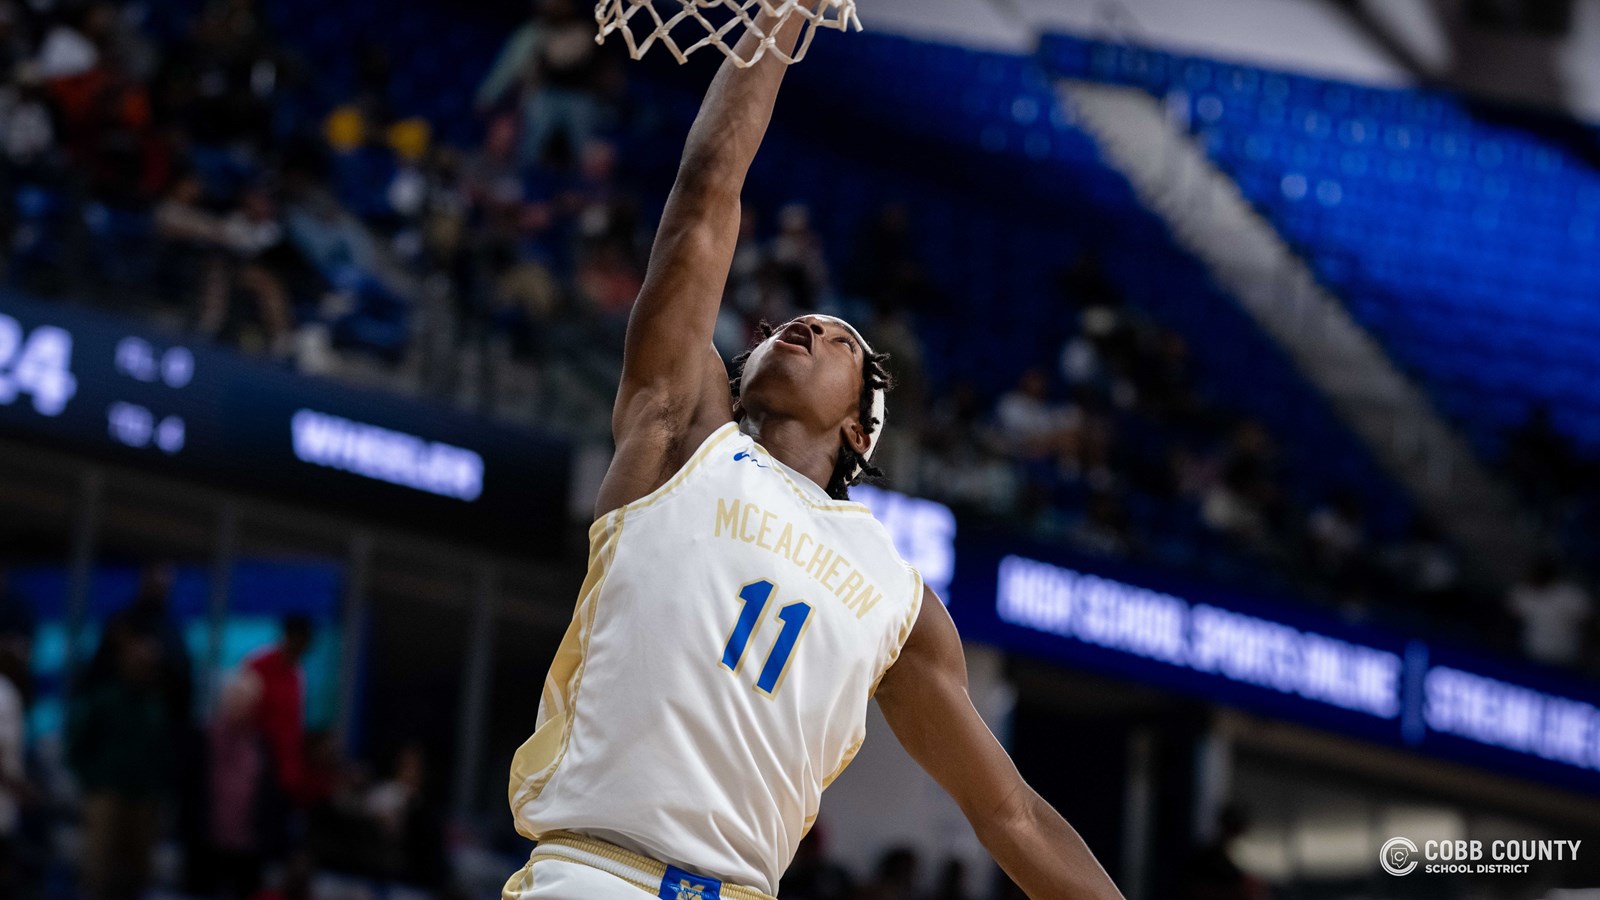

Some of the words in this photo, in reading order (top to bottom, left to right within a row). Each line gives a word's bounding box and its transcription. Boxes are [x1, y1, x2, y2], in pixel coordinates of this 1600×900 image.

[291, 409, 484, 501] WHEELER
[714, 498, 882, 620] MCEACHERN
[717, 577, 816, 701] 11
[1075, 574, 1188, 667] SCHOOL
